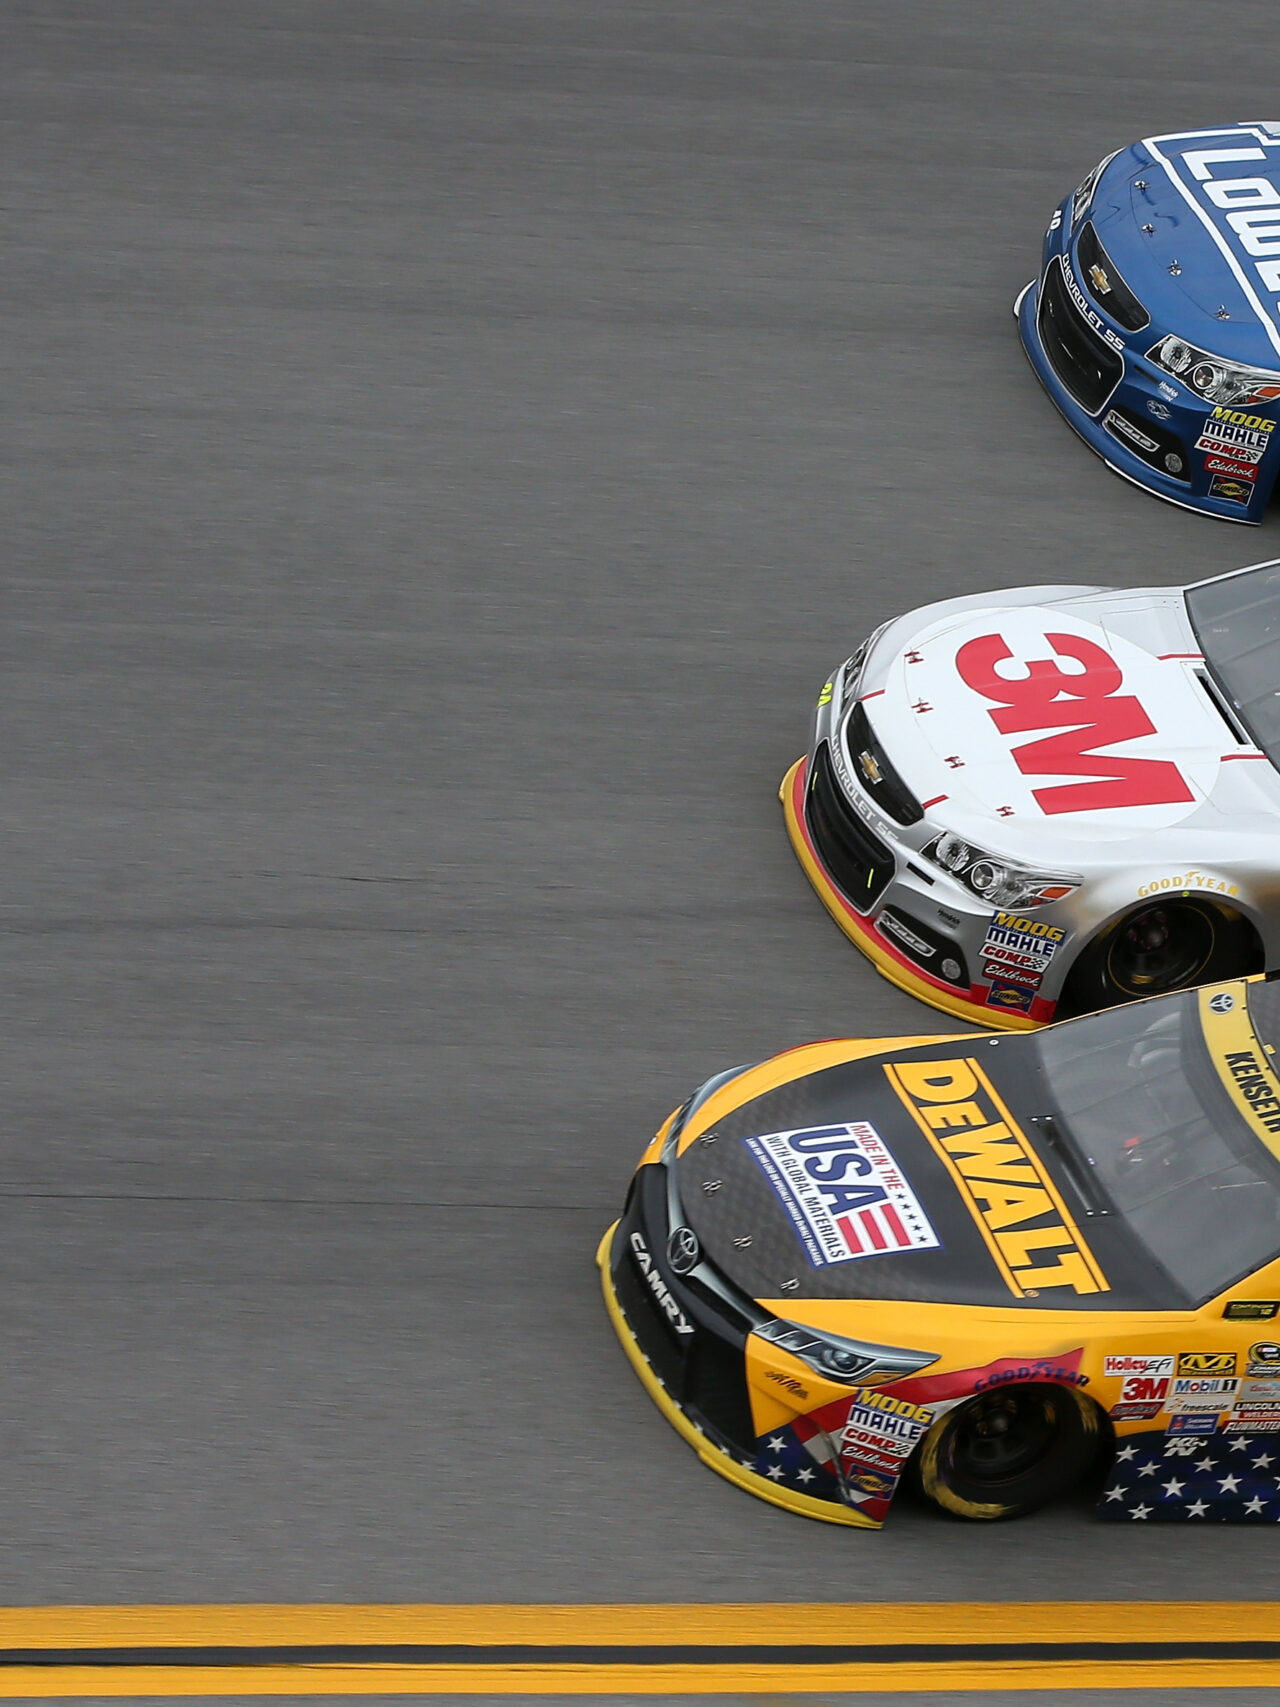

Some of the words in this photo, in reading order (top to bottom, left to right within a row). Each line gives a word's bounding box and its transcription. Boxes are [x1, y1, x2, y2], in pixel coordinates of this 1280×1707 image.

[1062, 253, 1104, 329] CHEVROLET
[1104, 328, 1126, 350] SS
[1211, 406, 1277, 432] MOOG
[1205, 420, 1267, 448] MAHLE
[1199, 439, 1246, 457] COMP
[1208, 459, 1254, 477] Edelbrock
[1213, 484, 1249, 496] SUNOCO
[955, 632, 1197, 816] 3M
[832, 734, 876, 821] CHEVROLET
[1137, 871, 1241, 897] GOODYEAR
[993, 912, 1065, 941] MOOG
[984, 945, 1031, 964] COMP
[987, 929, 1055, 956] MAHLE
[985, 964, 1040, 986] Edelbrock
[991, 990, 1031, 1004] SUNOCO
[851, 1125, 879, 1153] MADE
[788, 1127, 889, 1215] USA
[870, 1154, 891, 1166] IN
[880, 1168, 905, 1190] THE
[894, 1058, 1101, 1294] DEWALT
[766, 1136, 792, 1158] WITH
[781, 1158, 813, 1195] GLOBAL
[804, 1195, 846, 1258] MATERIALS
[630, 1232, 694, 1333] CAMRY
[974, 1362, 1090, 1391] GOODYEAR
[1106, 1358, 1147, 1373] Holley
[1145, 1358, 1174, 1373] EFI
[1123, 1378, 1170, 1400] 3M
[1175, 1380, 1219, 1392] Mobil
[1224, 1380, 1236, 1391] 1
[856, 1390, 933, 1423] MOOG
[1181, 1403, 1228, 1412] freescale
[851, 1408, 921, 1440] MAHLE
[845, 1428, 895, 1449] COMP
[842, 1447, 899, 1472] Edelbrock
[851, 1474, 892, 1491] SUNOCO
